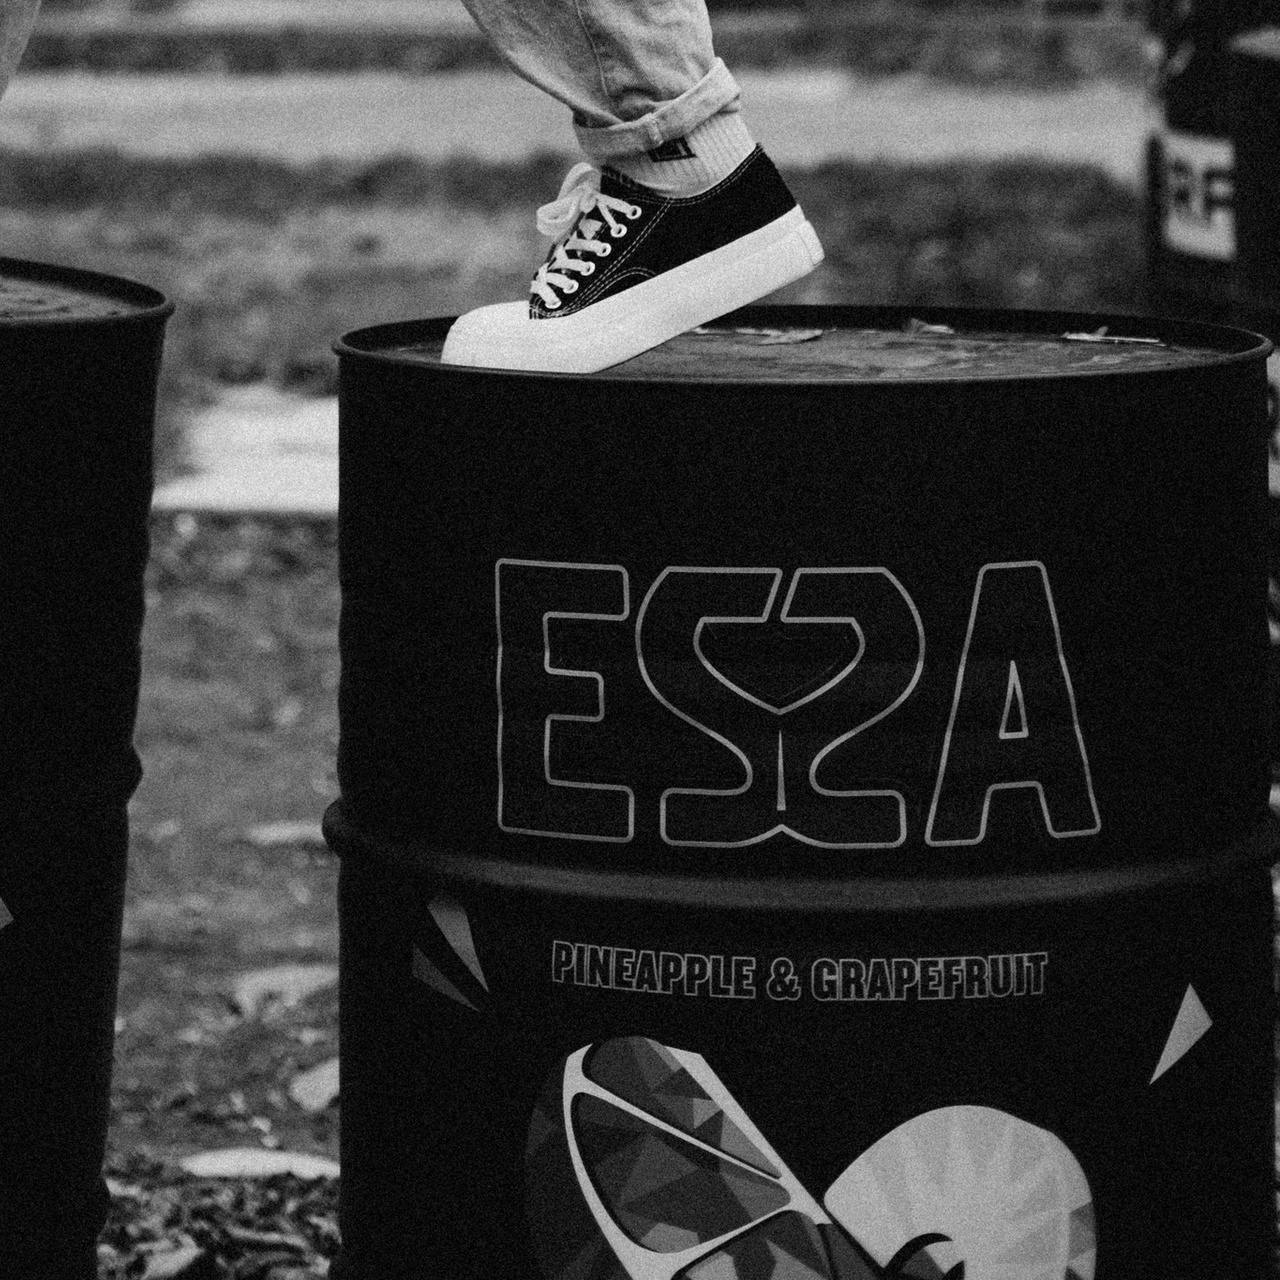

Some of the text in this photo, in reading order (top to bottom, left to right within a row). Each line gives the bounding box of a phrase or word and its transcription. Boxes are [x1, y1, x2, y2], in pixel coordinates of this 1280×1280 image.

[551, 940, 1050, 1002] PINEAPPLE & GRAPEFRUIT
